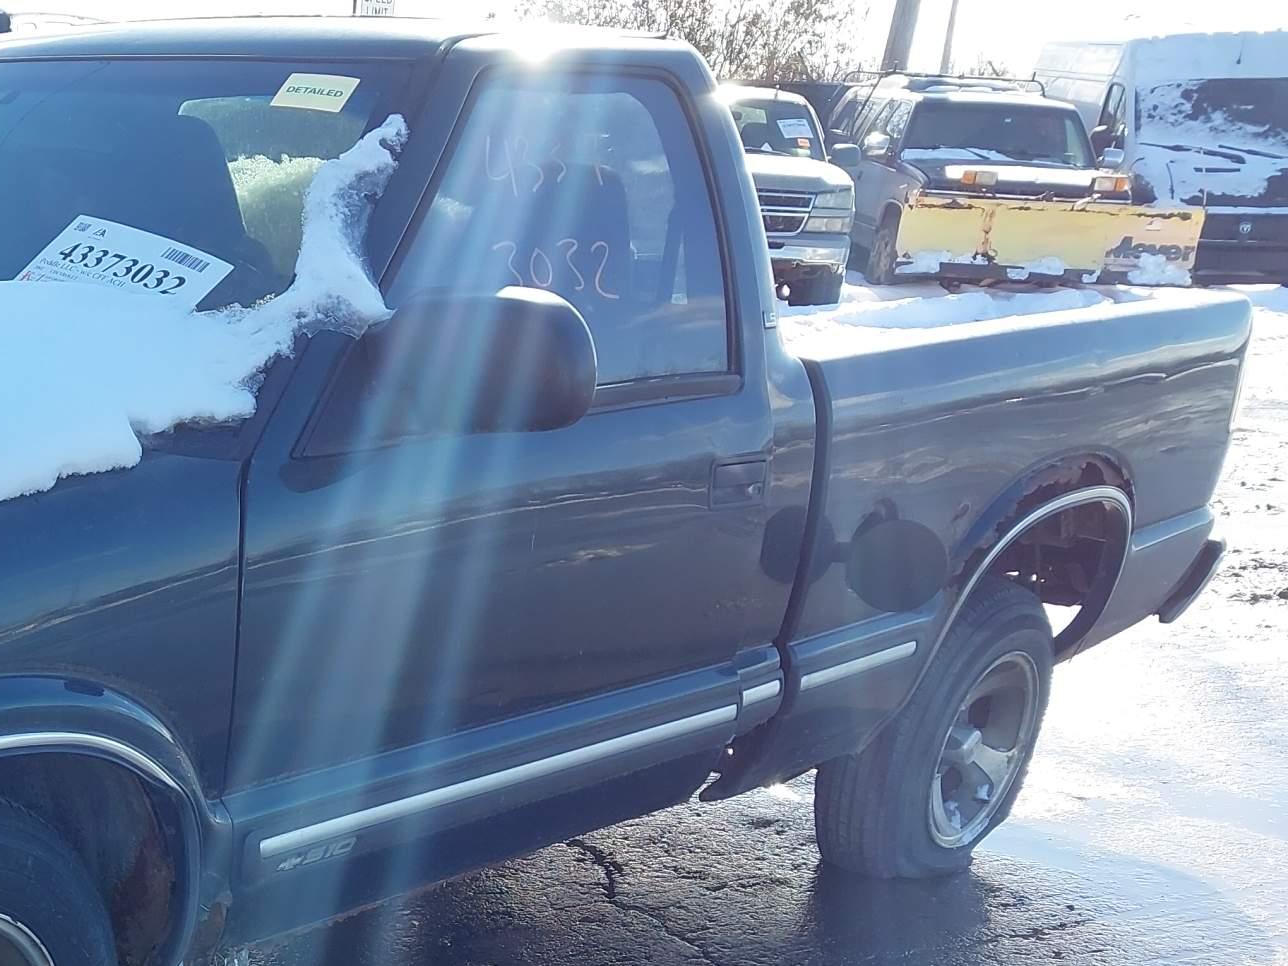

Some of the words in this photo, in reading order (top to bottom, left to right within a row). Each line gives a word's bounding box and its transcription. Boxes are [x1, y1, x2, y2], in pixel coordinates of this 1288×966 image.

[286, 85, 344, 98] DETAILED
[59, 242, 187, 295] 43373032
[492, 238, 620, 299] 3032
